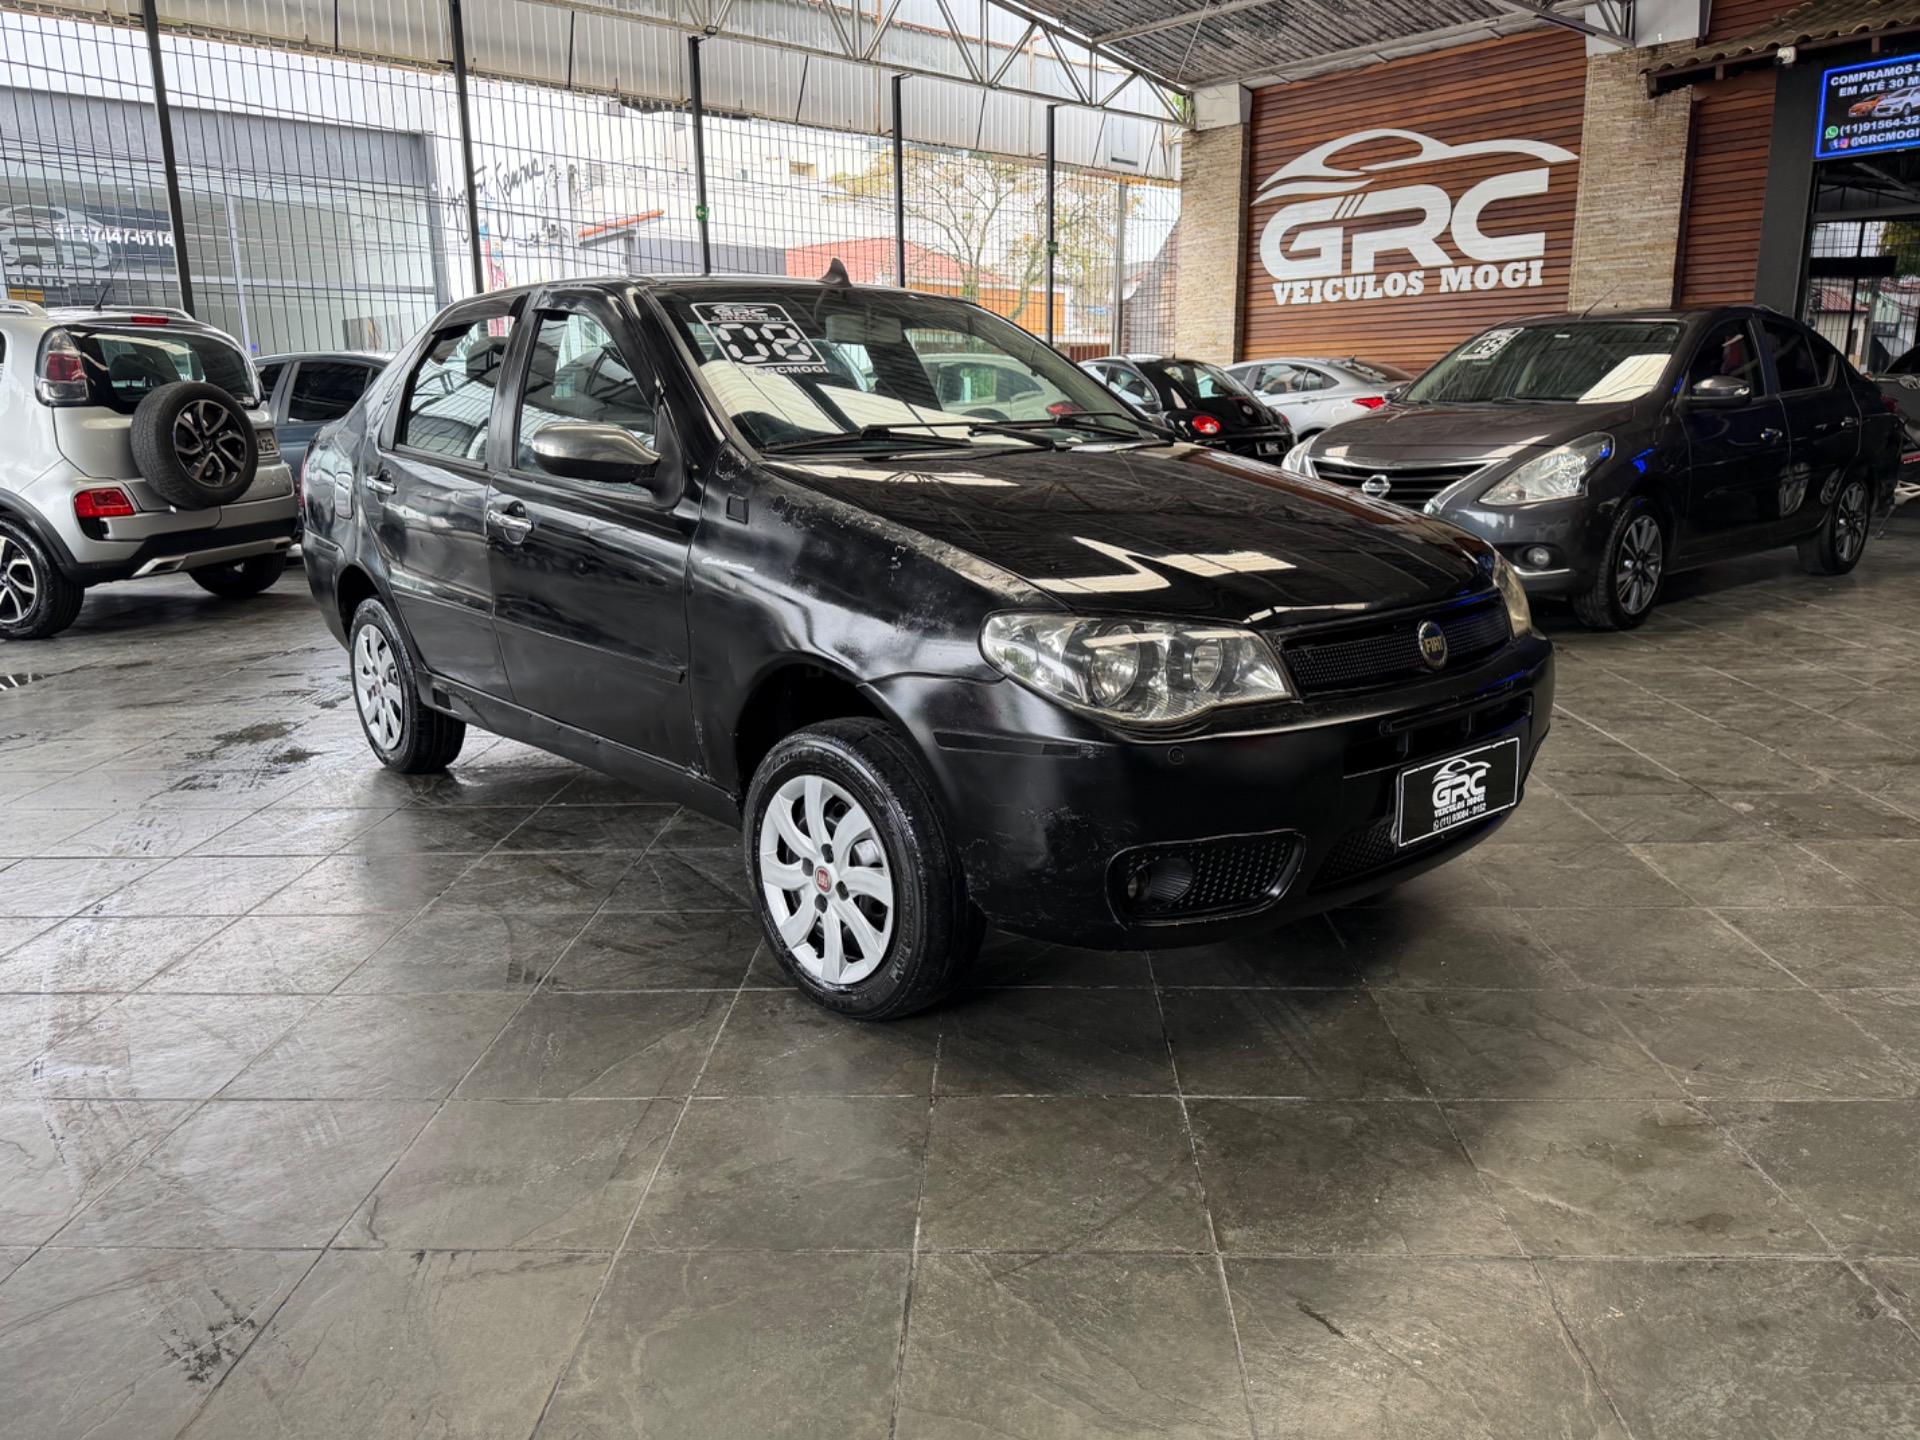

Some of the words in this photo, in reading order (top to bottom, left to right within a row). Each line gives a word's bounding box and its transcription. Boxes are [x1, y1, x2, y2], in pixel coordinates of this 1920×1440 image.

[1830, 64, 1913, 86] COMPRAMOS
[1838, 85, 1858, 98] EM
[1860, 80, 1885, 94] ATÉ
[1888, 78, 1905, 89] 30
[1259, 167, 1550, 281] GRC
[1272, 270, 1425, 305] VEICULOS
[1439, 260, 1544, 294] MOGI
[717, 323, 813, 363] 08
[1432, 768, 1486, 809] GRC
